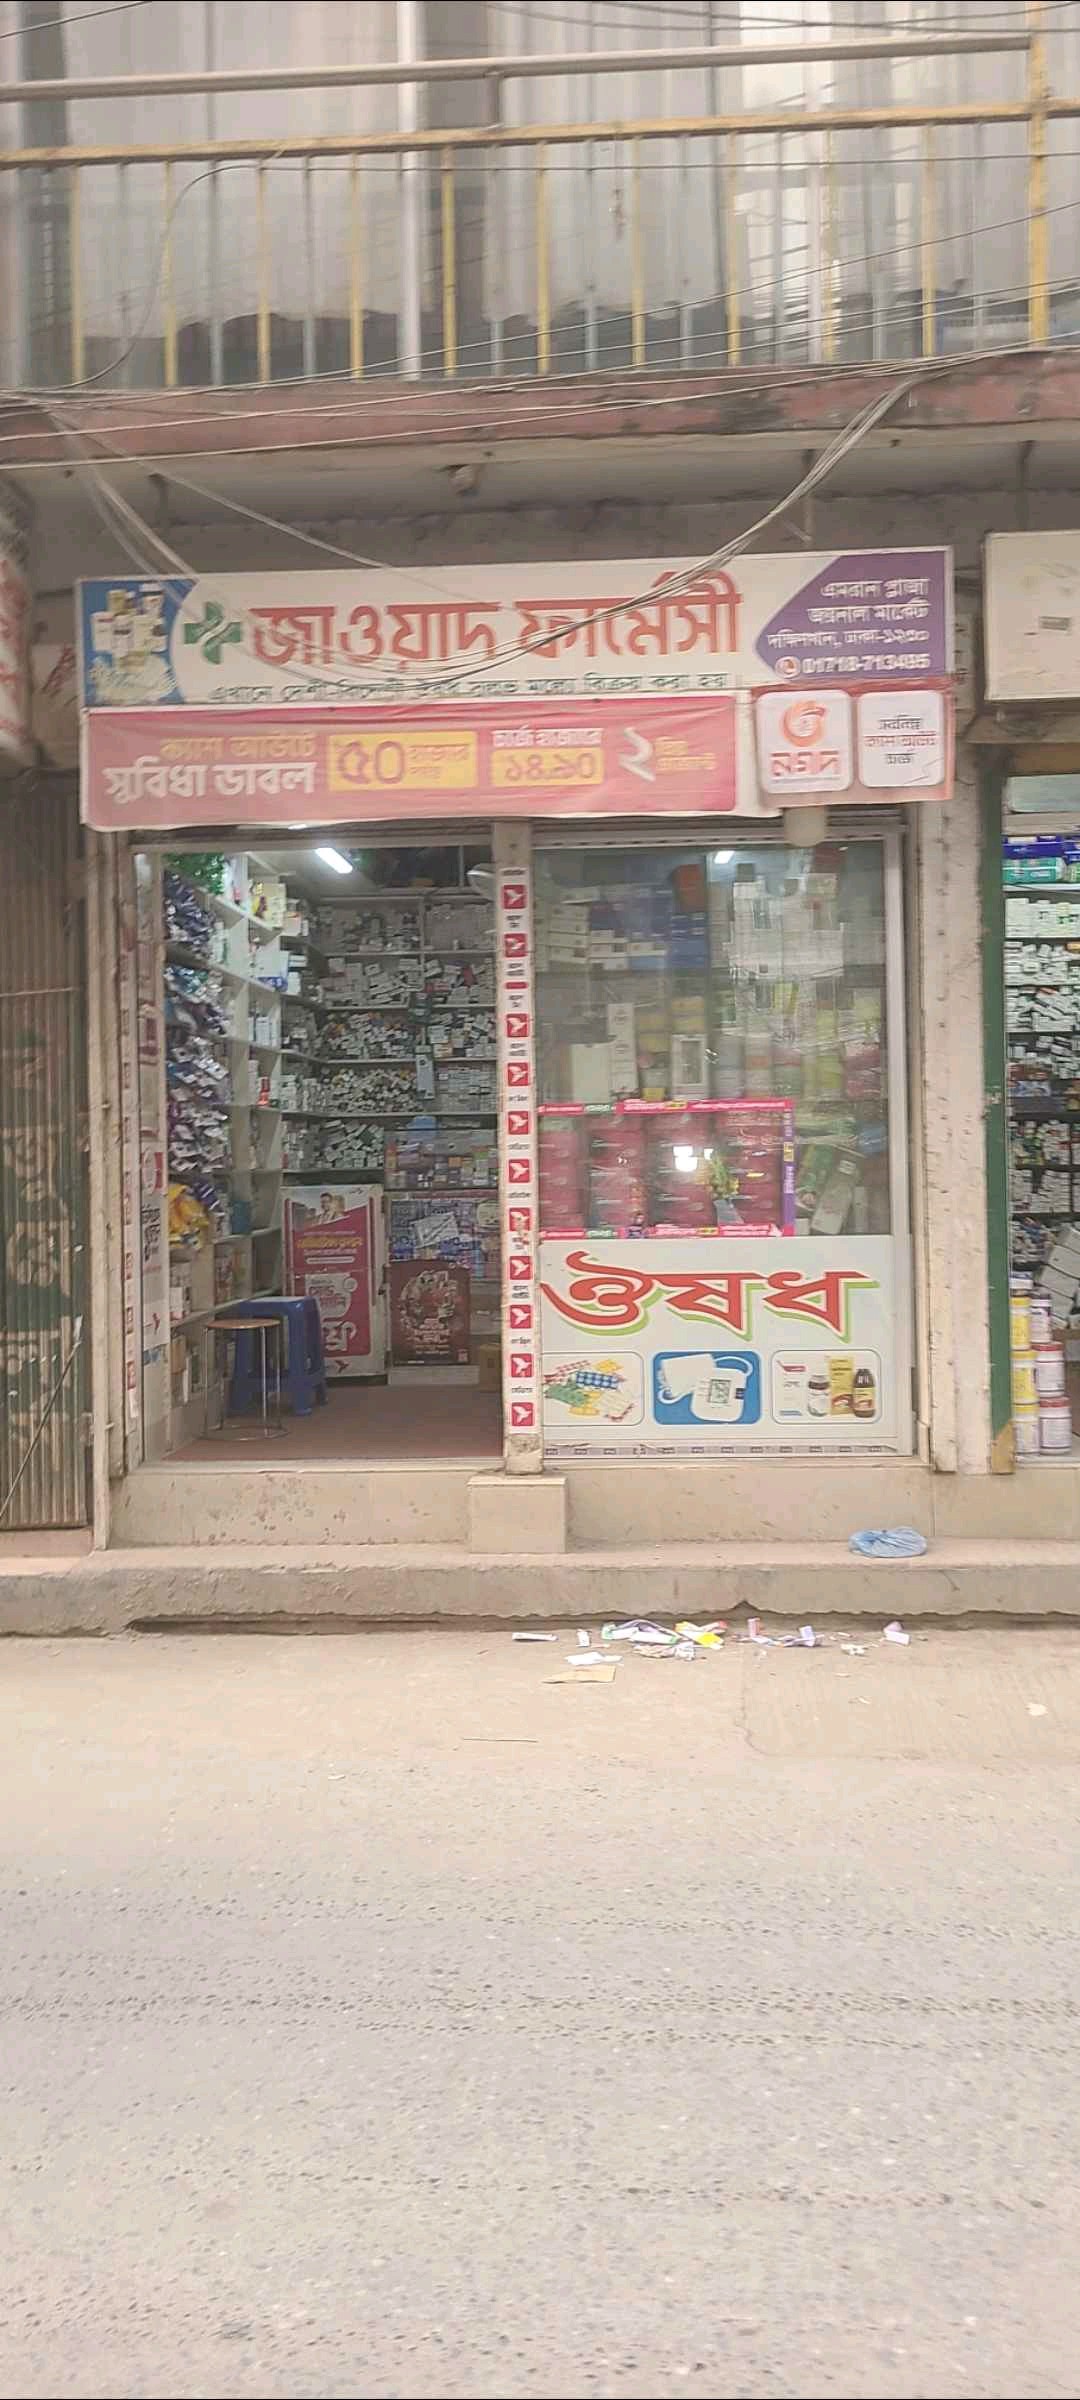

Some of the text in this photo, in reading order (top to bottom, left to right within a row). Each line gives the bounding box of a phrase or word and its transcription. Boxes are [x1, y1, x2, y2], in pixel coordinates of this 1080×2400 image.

[248, 570, 744, 674] জাওয়াদ ফার্মেসী
[104, 757, 316, 803] সুবিধা ডাবল
[334, 739, 405, 785] ৫০
[769, 750, 841, 778] নগদ
[539, 1250, 876, 1342] ঔষধ
